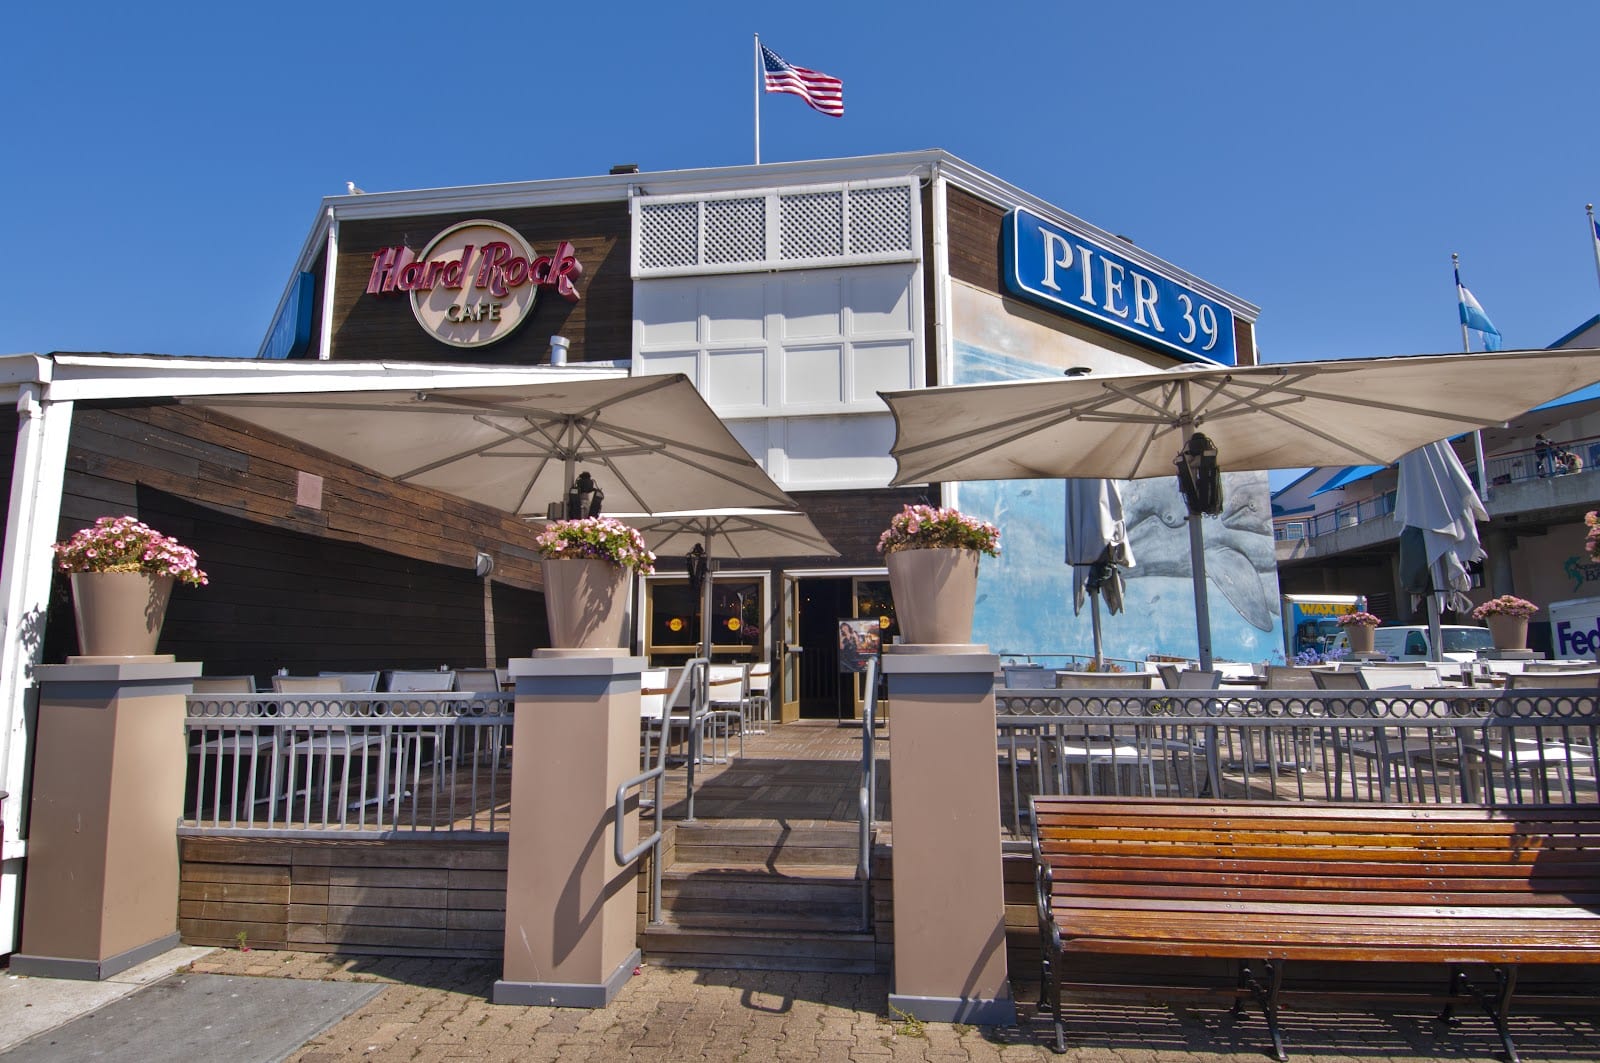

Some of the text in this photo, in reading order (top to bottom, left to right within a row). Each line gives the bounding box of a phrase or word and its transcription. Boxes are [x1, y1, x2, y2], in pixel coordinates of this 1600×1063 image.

[366, 241, 583, 301] Hard Rock
[1038, 226, 1218, 351] PIER 39
[445, 303, 502, 322] CAFE
